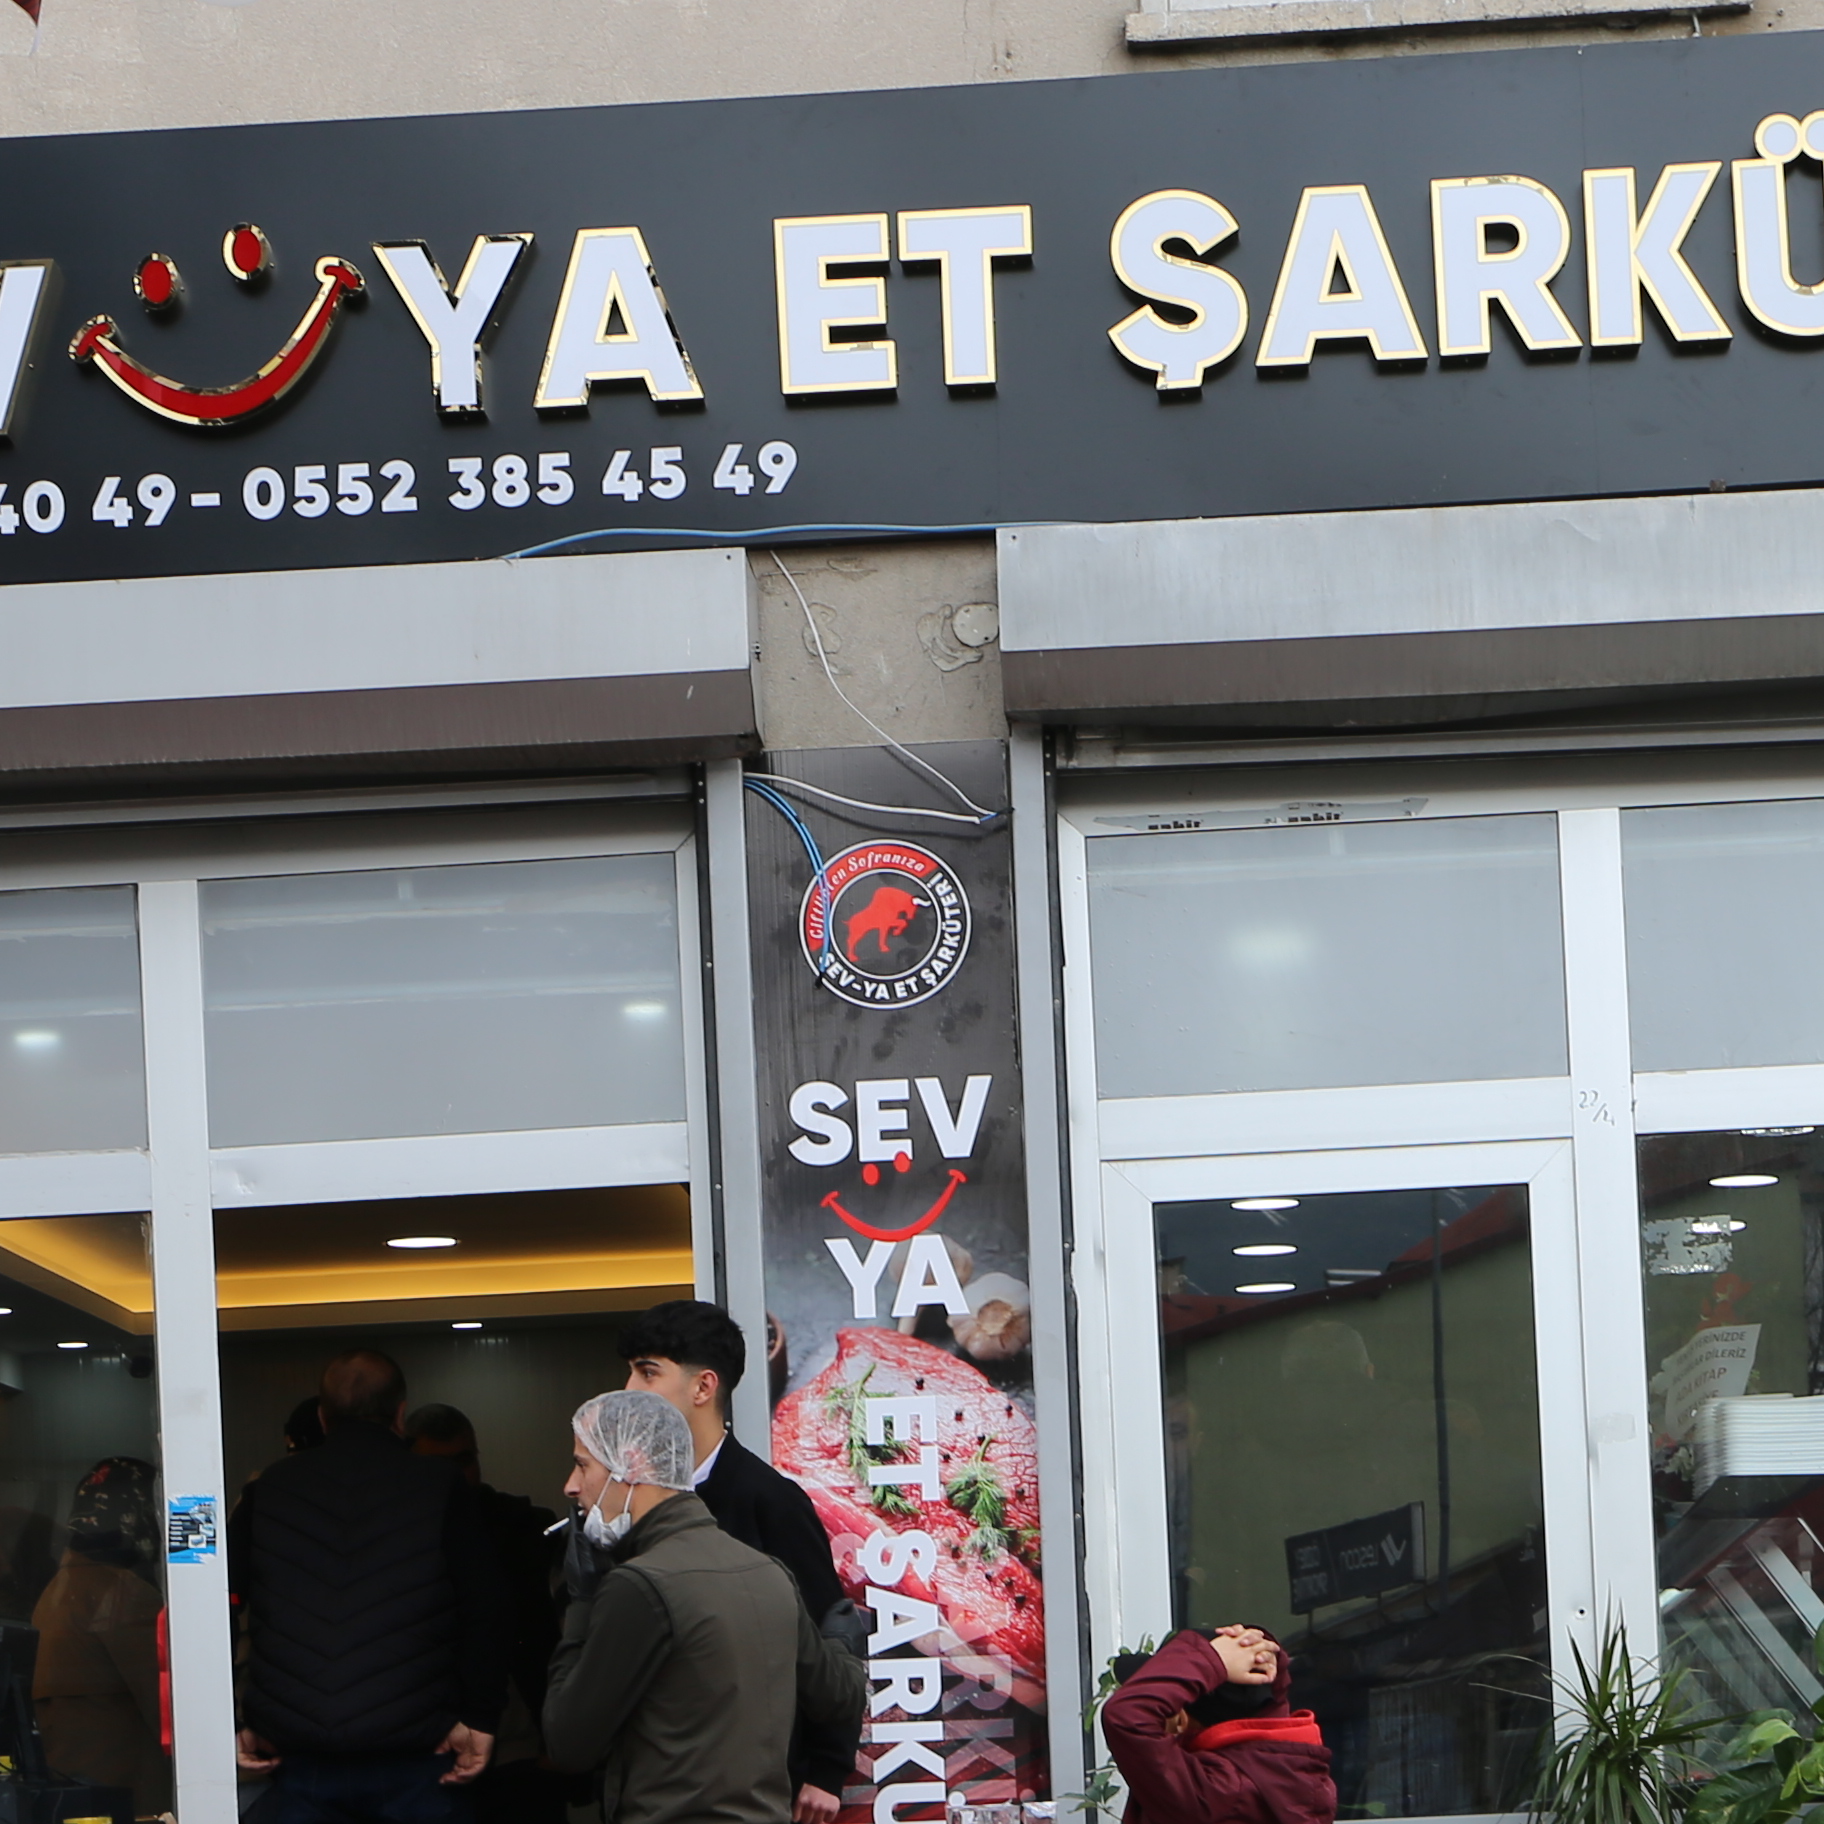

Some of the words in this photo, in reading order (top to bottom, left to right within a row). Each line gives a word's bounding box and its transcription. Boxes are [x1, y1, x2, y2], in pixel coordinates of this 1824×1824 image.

[373, 226, 707, 421] YA
[774, 203, 1034, 399] ET
[92, 474, 172, 529] 49
[242, 460, 419, 520] 0552
[447, 451, 576, 511] 385
[602, 446, 684, 502] 45
[711, 440, 799, 498] 49
[894, 976, 918, 998] ET
[920, 872, 962, 987] ŞARKÜTERİ
[787, 1074, 993, 1167] SEV
[824, 1234, 970, 1319] YA
[866, 1395, 941, 1501] ET
